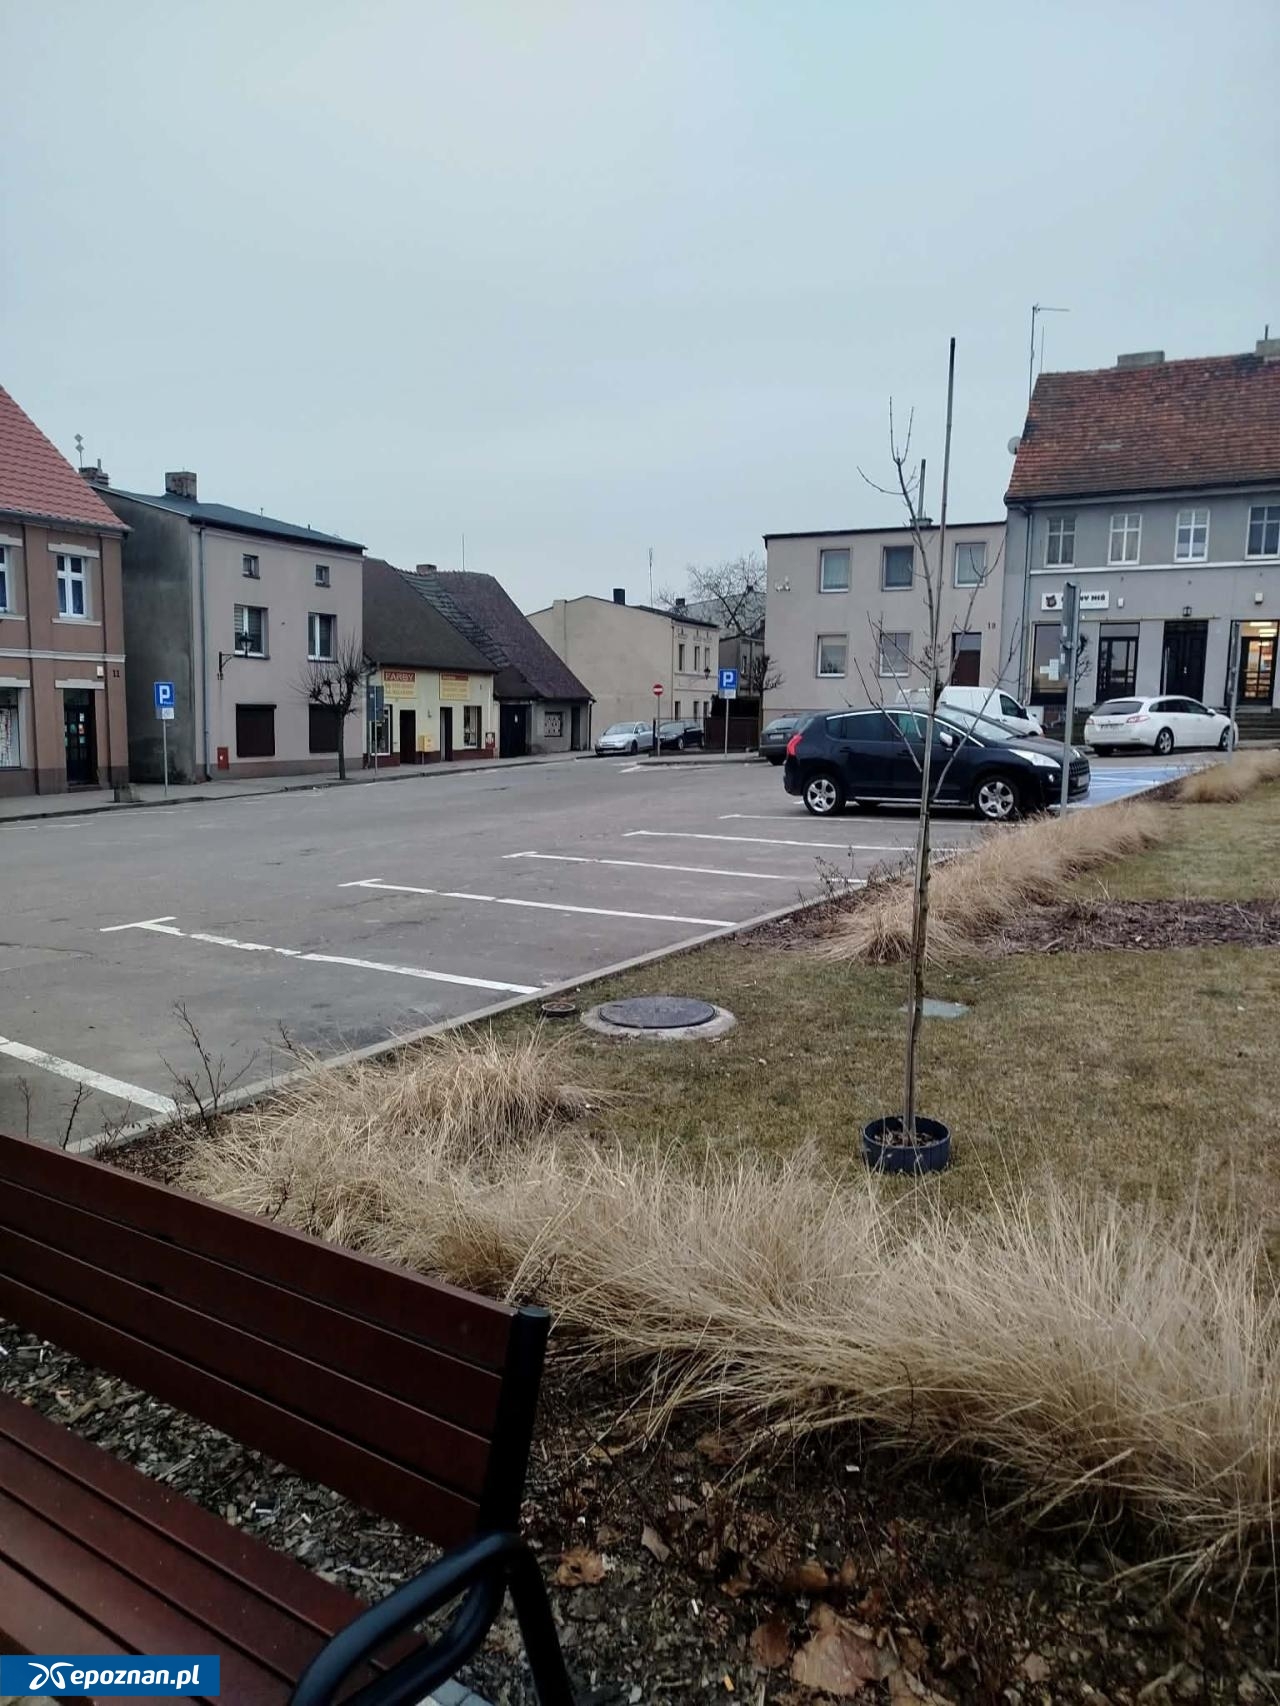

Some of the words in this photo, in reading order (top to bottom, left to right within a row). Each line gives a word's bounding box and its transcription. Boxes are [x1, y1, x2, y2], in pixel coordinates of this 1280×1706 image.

[385, 672, 414, 681] FARBY
[723, 671, 734, 687] P
[159, 685, 170, 704] P
